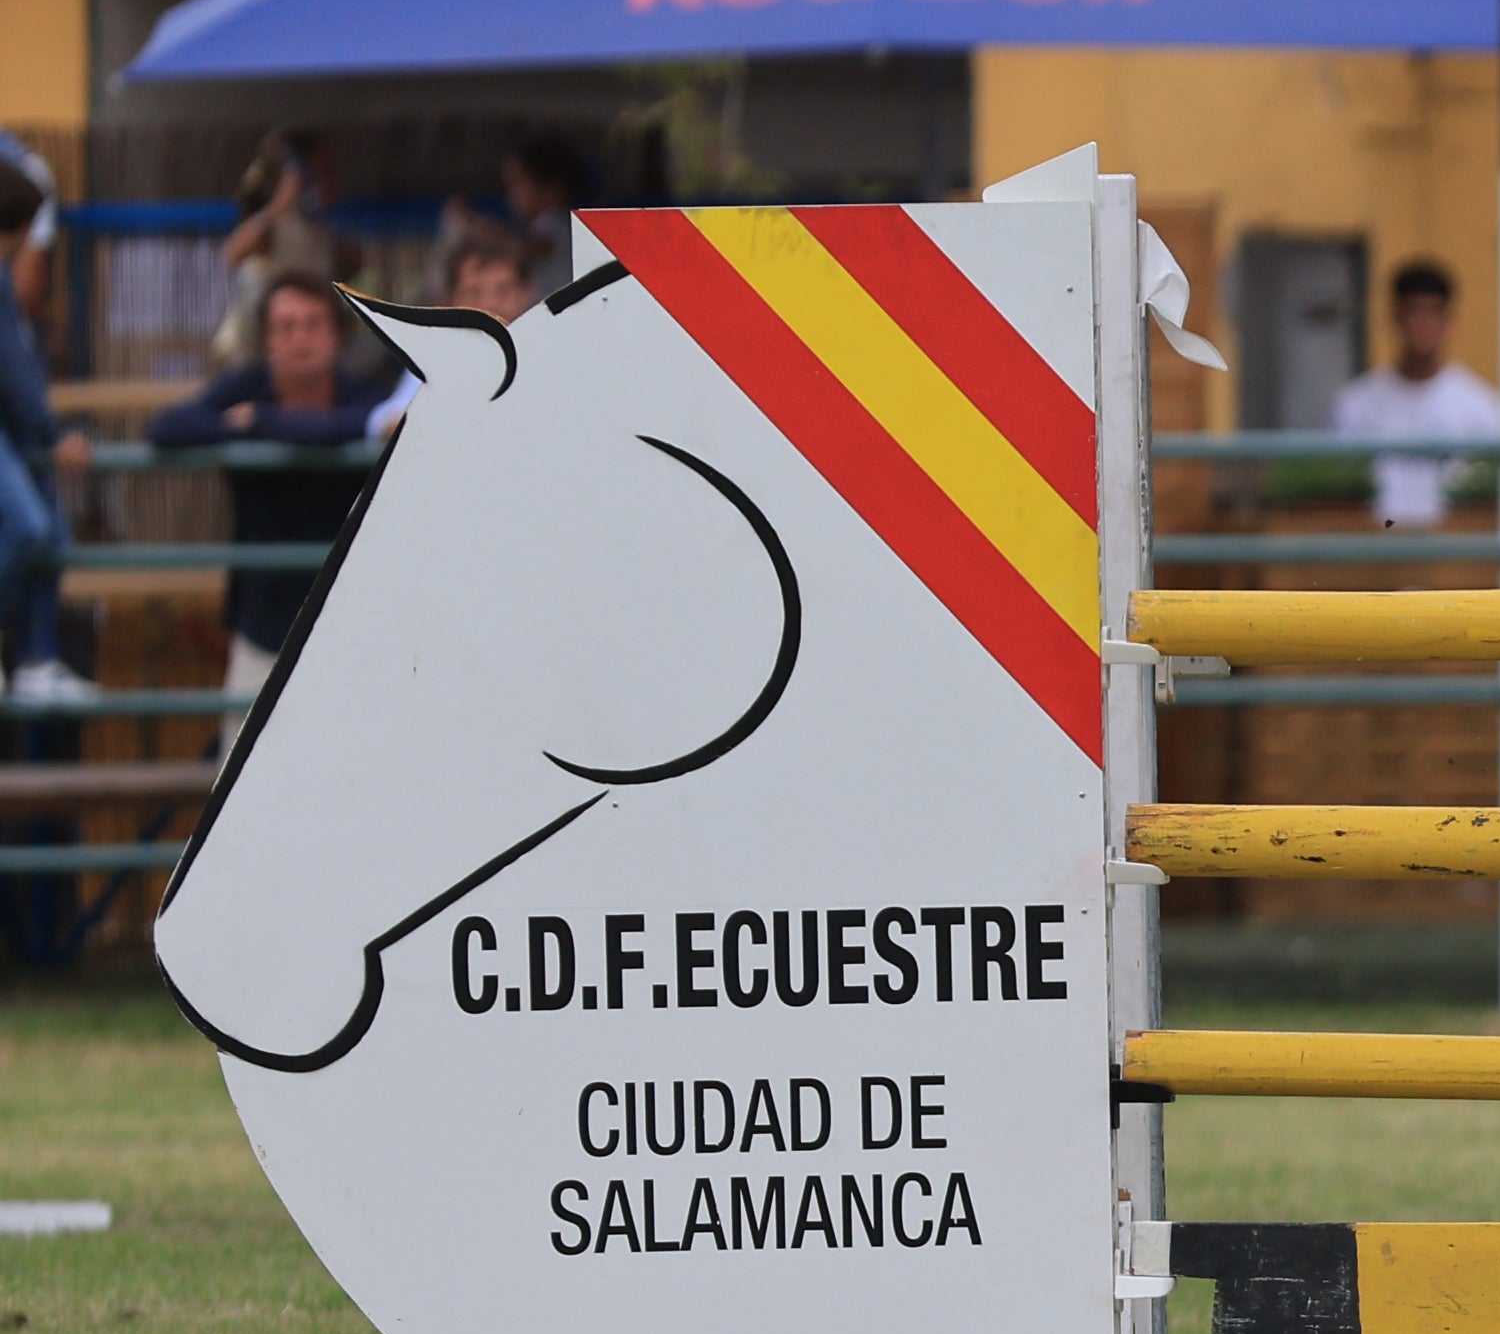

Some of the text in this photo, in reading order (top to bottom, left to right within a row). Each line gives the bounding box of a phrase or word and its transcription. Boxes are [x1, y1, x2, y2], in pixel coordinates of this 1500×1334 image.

[451, 904, 1069, 1015] C.D.F.ECUESTRE
[577, 1075, 948, 1157] CIUDAD DE
[549, 1172, 984, 1257] SALAMANCA
